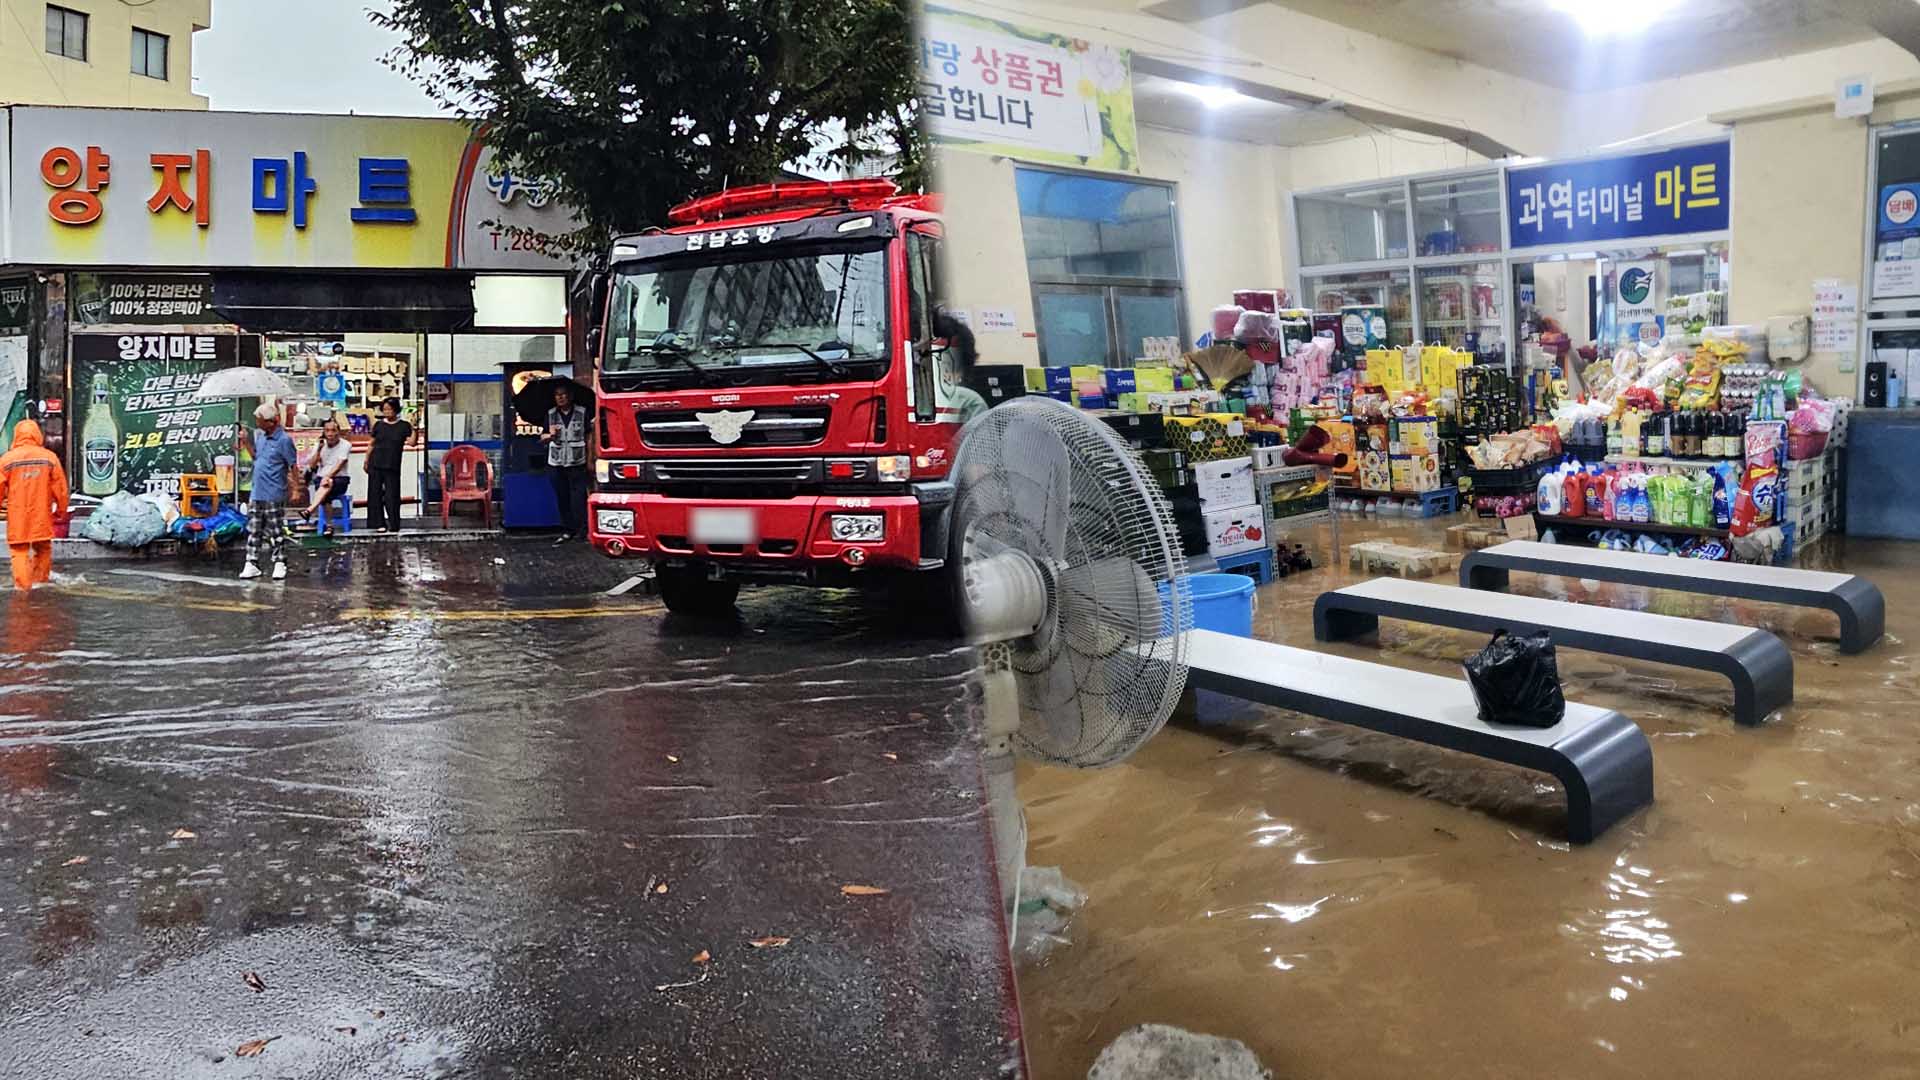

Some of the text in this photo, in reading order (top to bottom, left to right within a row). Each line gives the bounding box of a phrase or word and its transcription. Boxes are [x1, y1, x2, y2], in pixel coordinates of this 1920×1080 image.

[971, 46, 1064, 97] 상품권
[1518, 163, 1720, 232] 과역터미널 마트
[686, 226, 777, 251] 전남소방
[110, 284, 145, 298] 100%
[109, 301, 145, 315] 100%
[118, 336, 216, 360] 양지마트
[199, 425, 234, 441] 100%
[88, 450, 114, 460] TERRA
[144, 479, 181, 493] TERR
